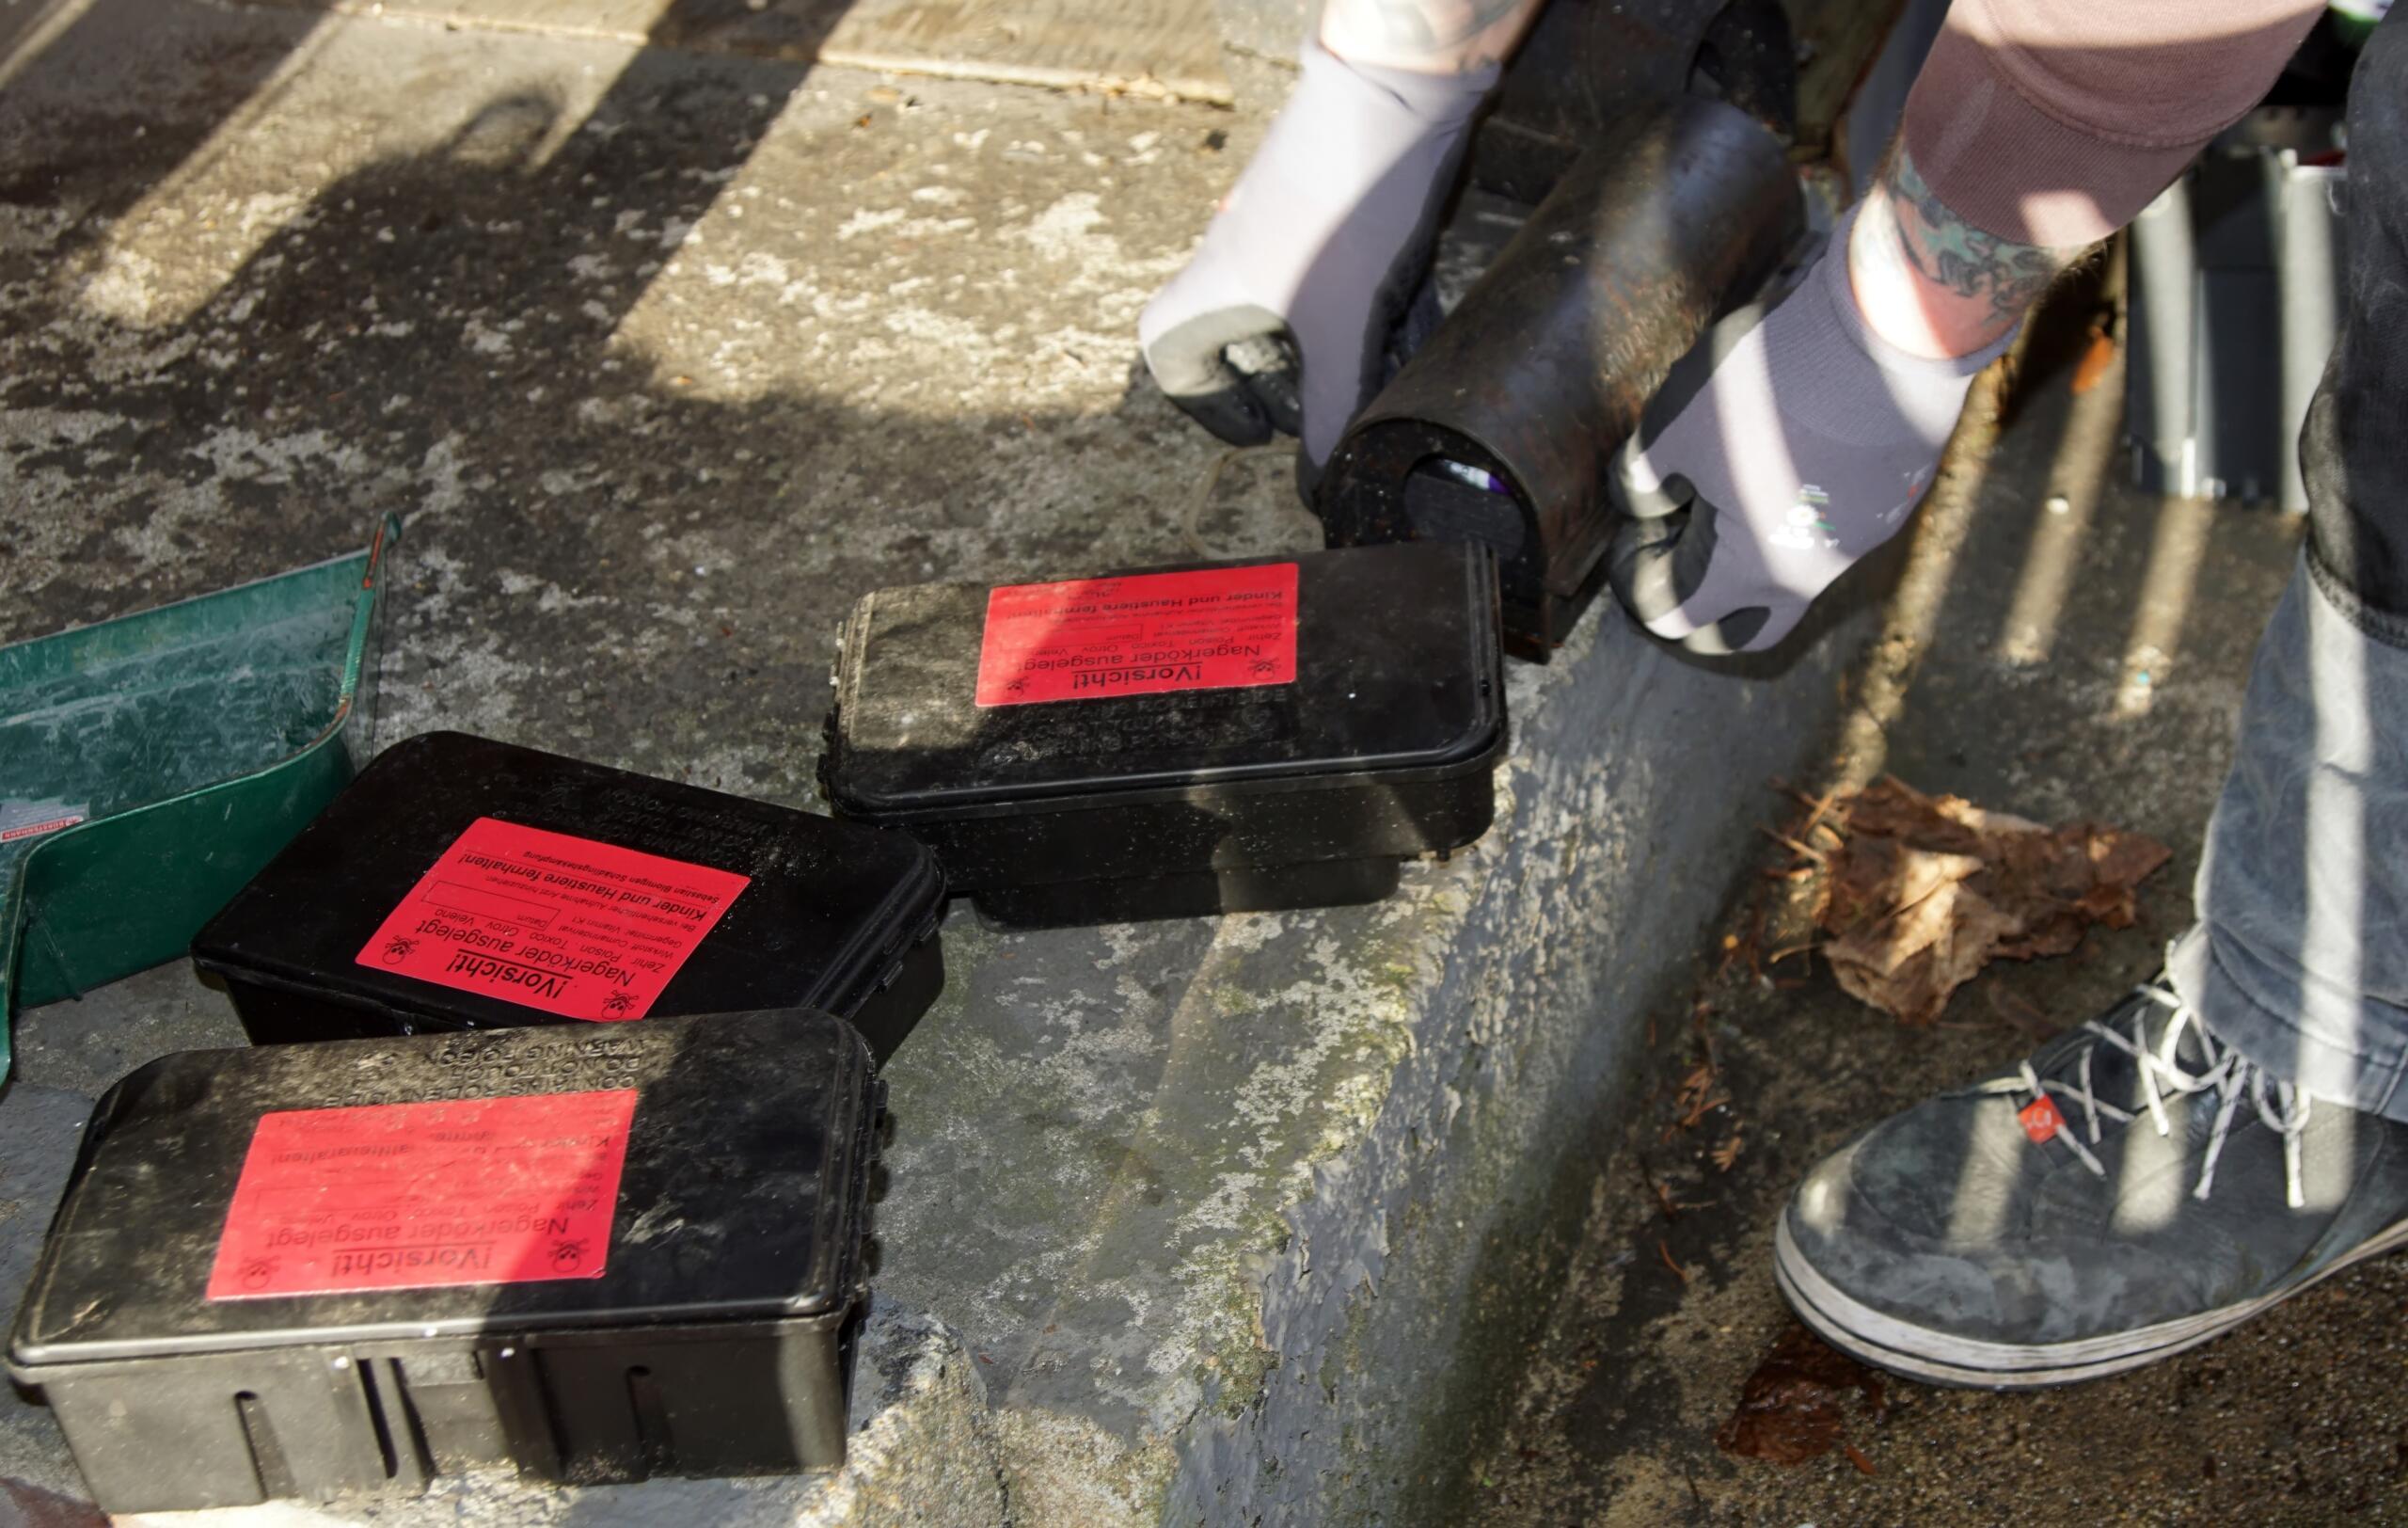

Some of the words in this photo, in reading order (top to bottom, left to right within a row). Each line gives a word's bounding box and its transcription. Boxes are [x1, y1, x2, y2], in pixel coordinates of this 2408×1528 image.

[1101, 598, 1181, 612] Haustiere
[1188, 596, 1219, 605] und
[1226, 591, 1281, 602] Kinder
[1188, 635, 1233, 646] Poison
[1023, 647, 1068, 658] Vele
[1130, 641, 1259, 665] Nagerköder
[1072, 664, 1201, 689] !Vorsicht!
[456, 853, 543, 882] fernhalten!
[539, 873, 619, 899] Haustiere
[616, 891, 652, 908] und
[649, 899, 708, 922] Kinder
[411, 916, 517, 955] ausgelegt
[525, 931, 570, 949] Toxico
[513, 942, 639, 986] Nagerköder
[576, 944, 624, 963] Poison
[627, 956, 666, 973] Zehir
[443, 953, 567, 998] !Vorsicht!
[263, 1220, 403, 1250] ausgelegt
[405, 1212, 570, 1244] Nagerköder
[329, 1246, 492, 1277] !Vorsicht!
